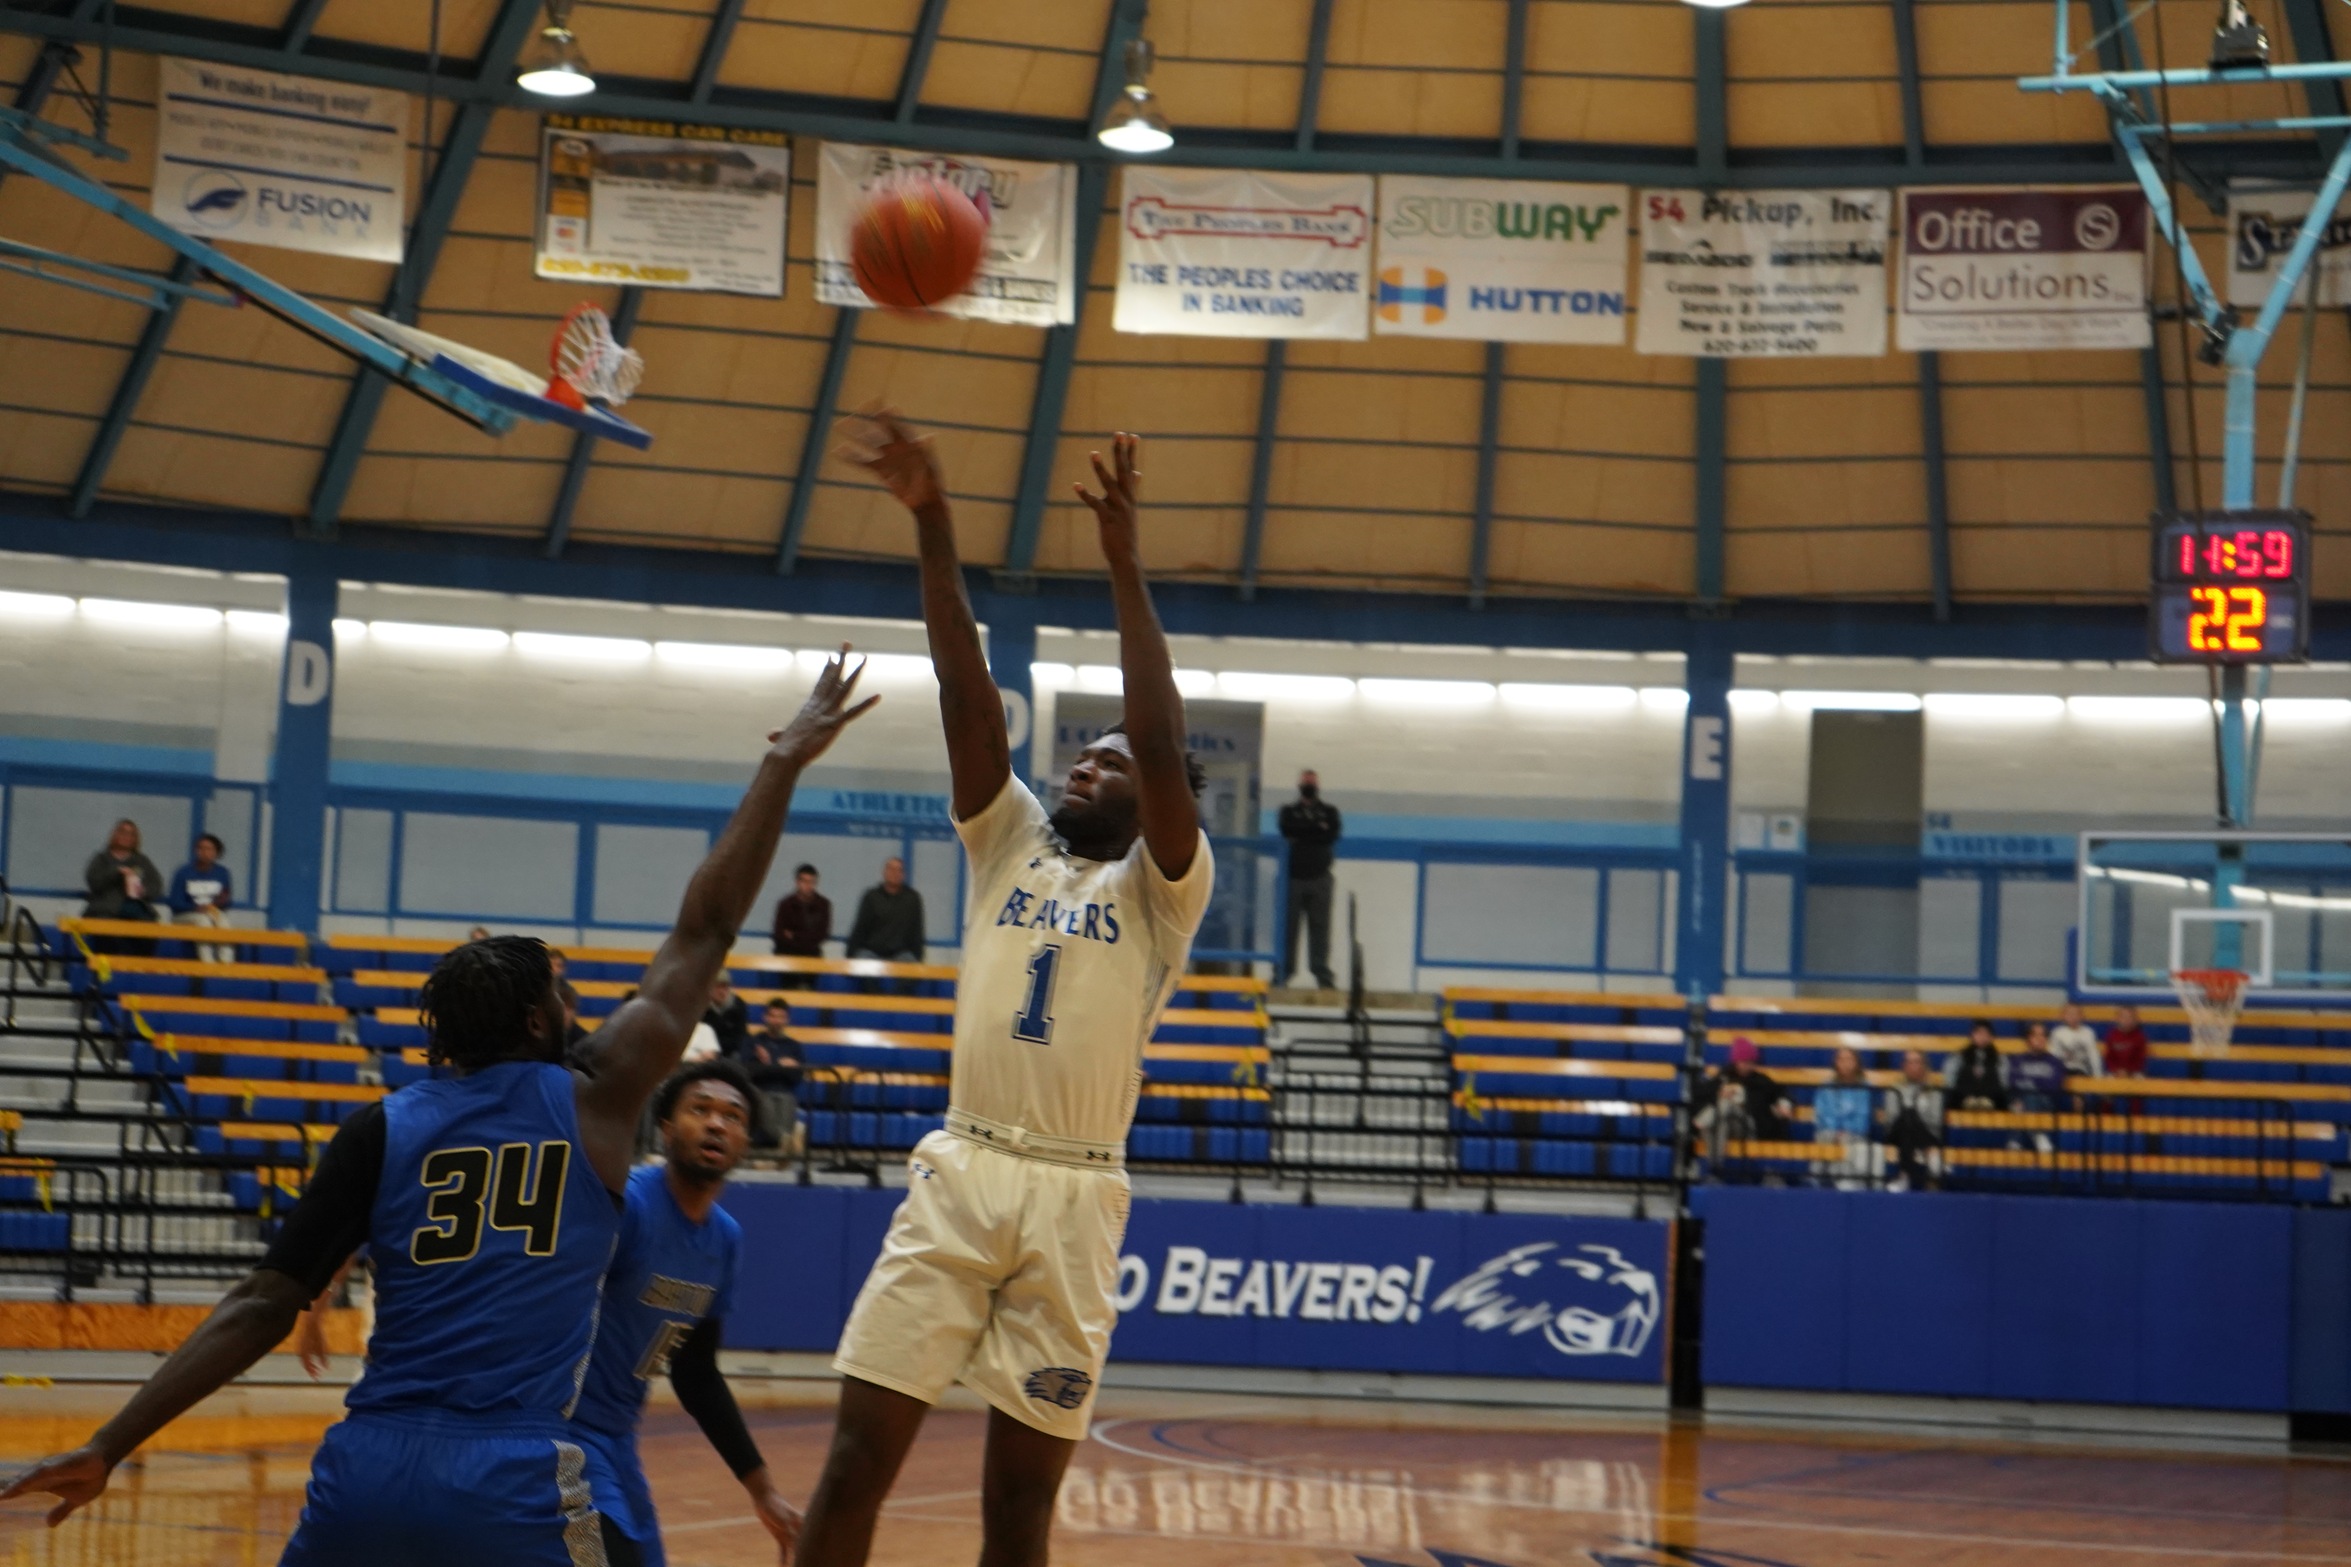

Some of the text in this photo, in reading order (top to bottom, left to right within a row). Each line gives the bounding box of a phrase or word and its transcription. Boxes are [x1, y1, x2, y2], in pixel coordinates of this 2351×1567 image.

[257, 187, 371, 223] FUSION
[1385, 195, 1621, 242] SUBWAY
[1830, 196, 1883, 223] Inc.
[1917, 207, 2042, 251] Office
[1129, 263, 1360, 293] THE PEOPLES CHOICE
[1470, 286, 1624, 316] HUTTON
[1913, 261, 2111, 302] Solutions
[1182, 293, 1304, 317] IN BANKING
[2180, 530, 2293, 578] 11:59
[287, 640, 329, 706] D
[1689, 715, 1723, 781] E
[995, 885, 1120, 944] BEAVERS
[1010, 943, 1063, 1046] 1
[410, 1140, 571, 1266] 34
[1113, 1246, 1434, 1326] O BEAVERS!
